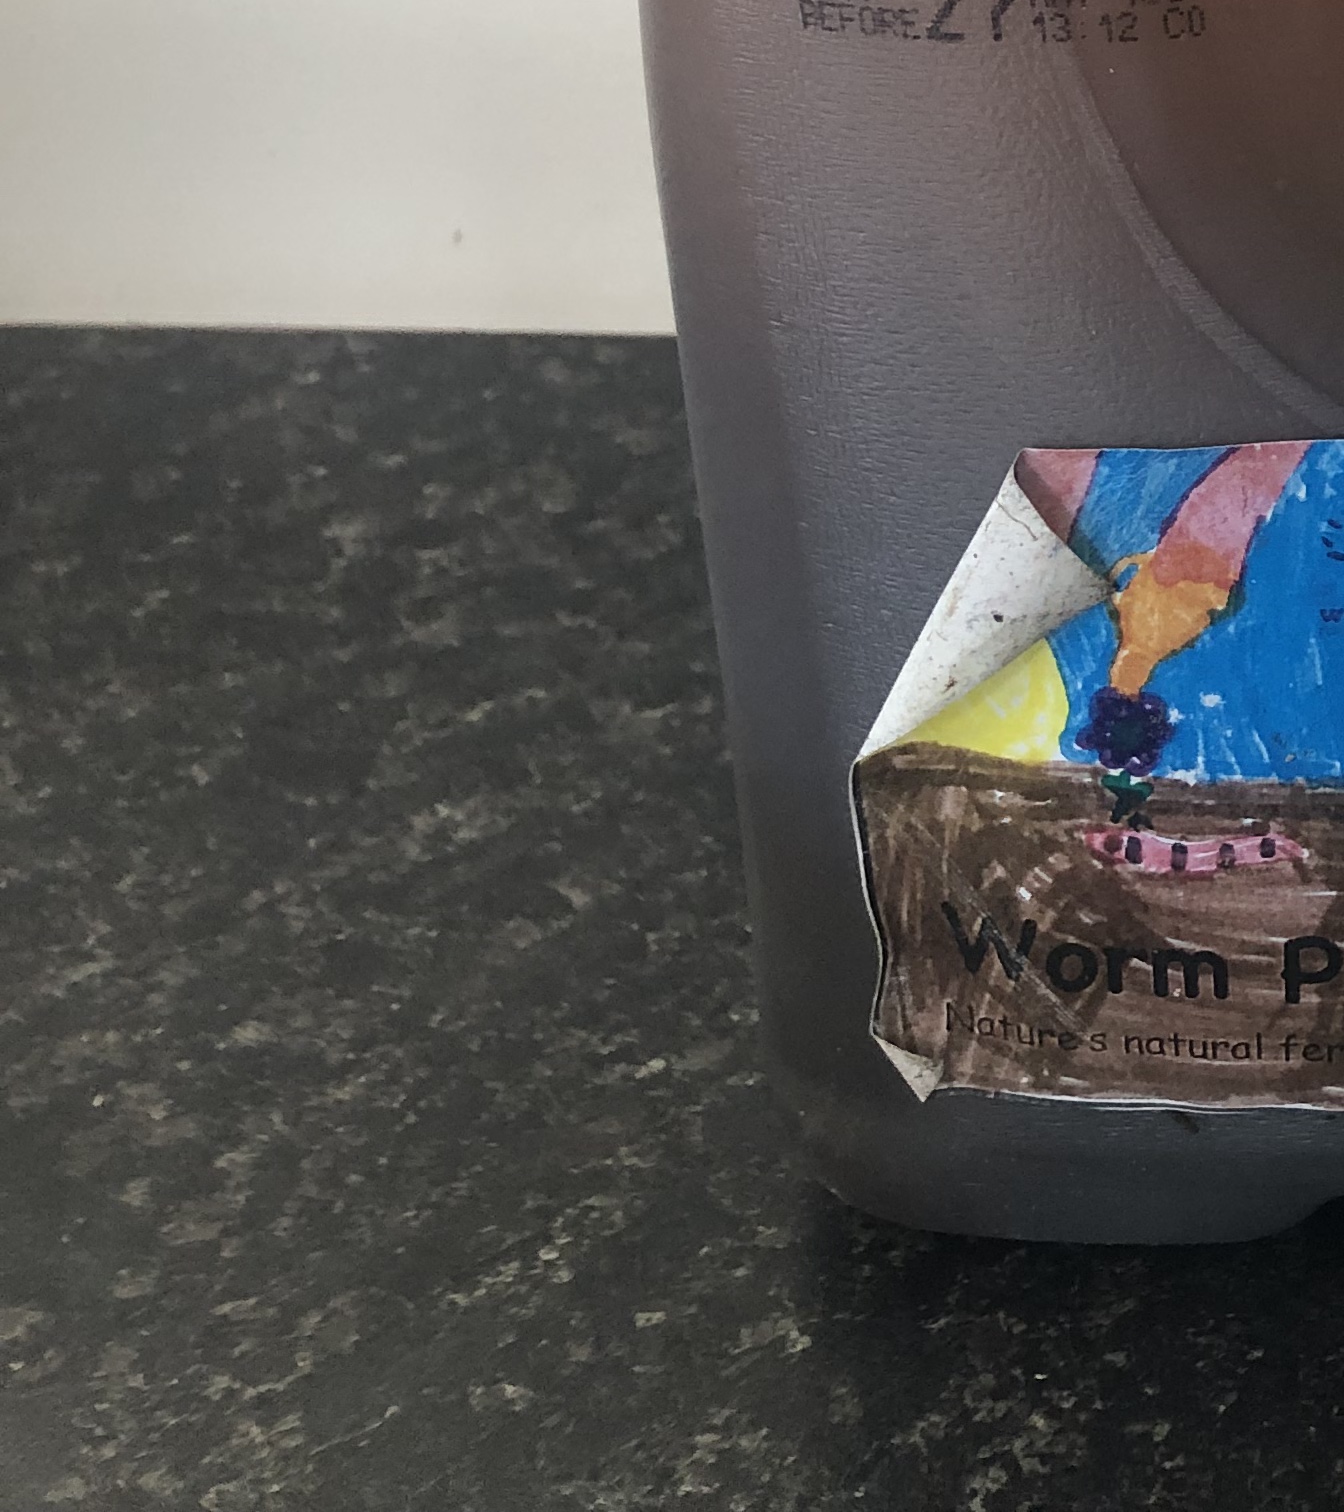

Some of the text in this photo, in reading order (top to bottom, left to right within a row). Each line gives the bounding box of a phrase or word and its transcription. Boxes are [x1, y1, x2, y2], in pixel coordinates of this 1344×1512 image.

[940, 901, 1230, 999] Worm
[945, 1001, 1108, 1052] Natures
[1124, 1032, 1263, 1061] natural
